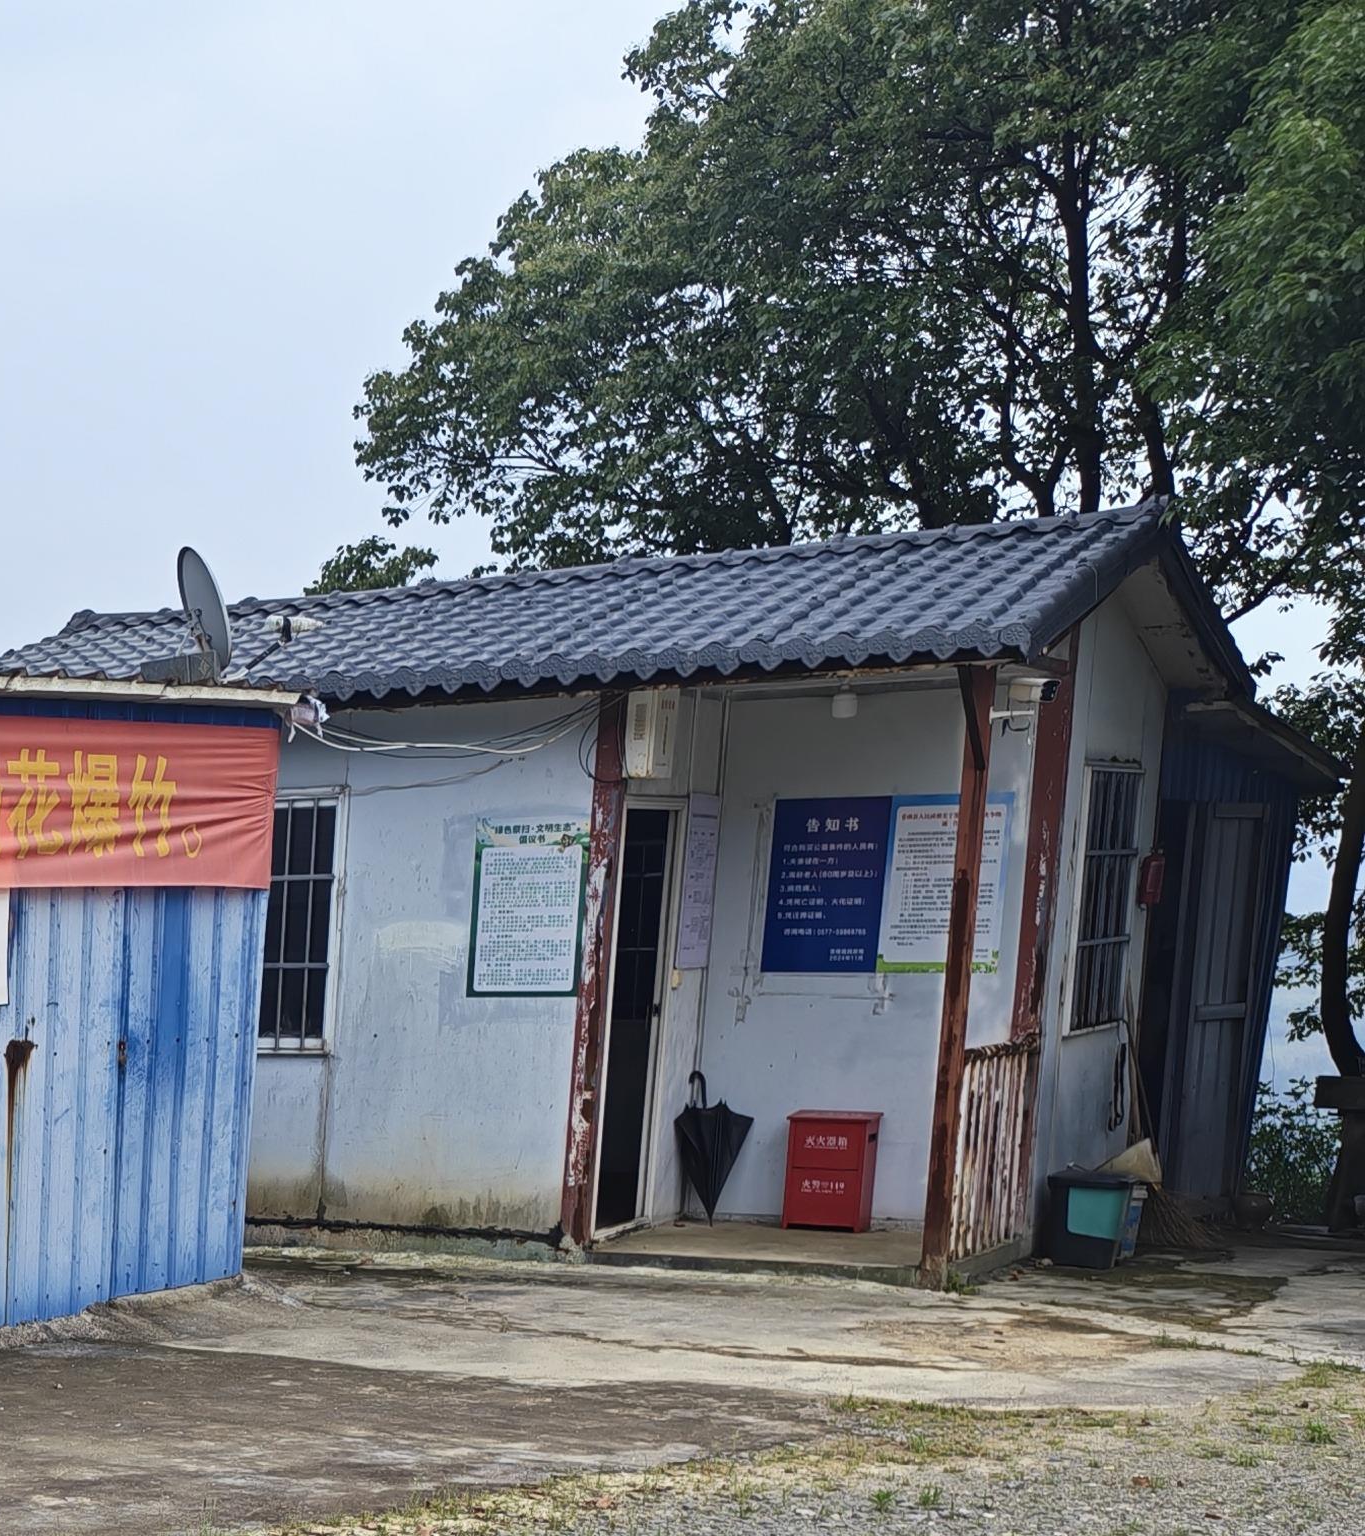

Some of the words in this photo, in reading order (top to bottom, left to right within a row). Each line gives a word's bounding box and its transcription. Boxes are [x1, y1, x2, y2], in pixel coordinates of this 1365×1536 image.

[805, 816, 860, 832] 告知书
[805, 1135, 848, 1146] 灭火器箱
